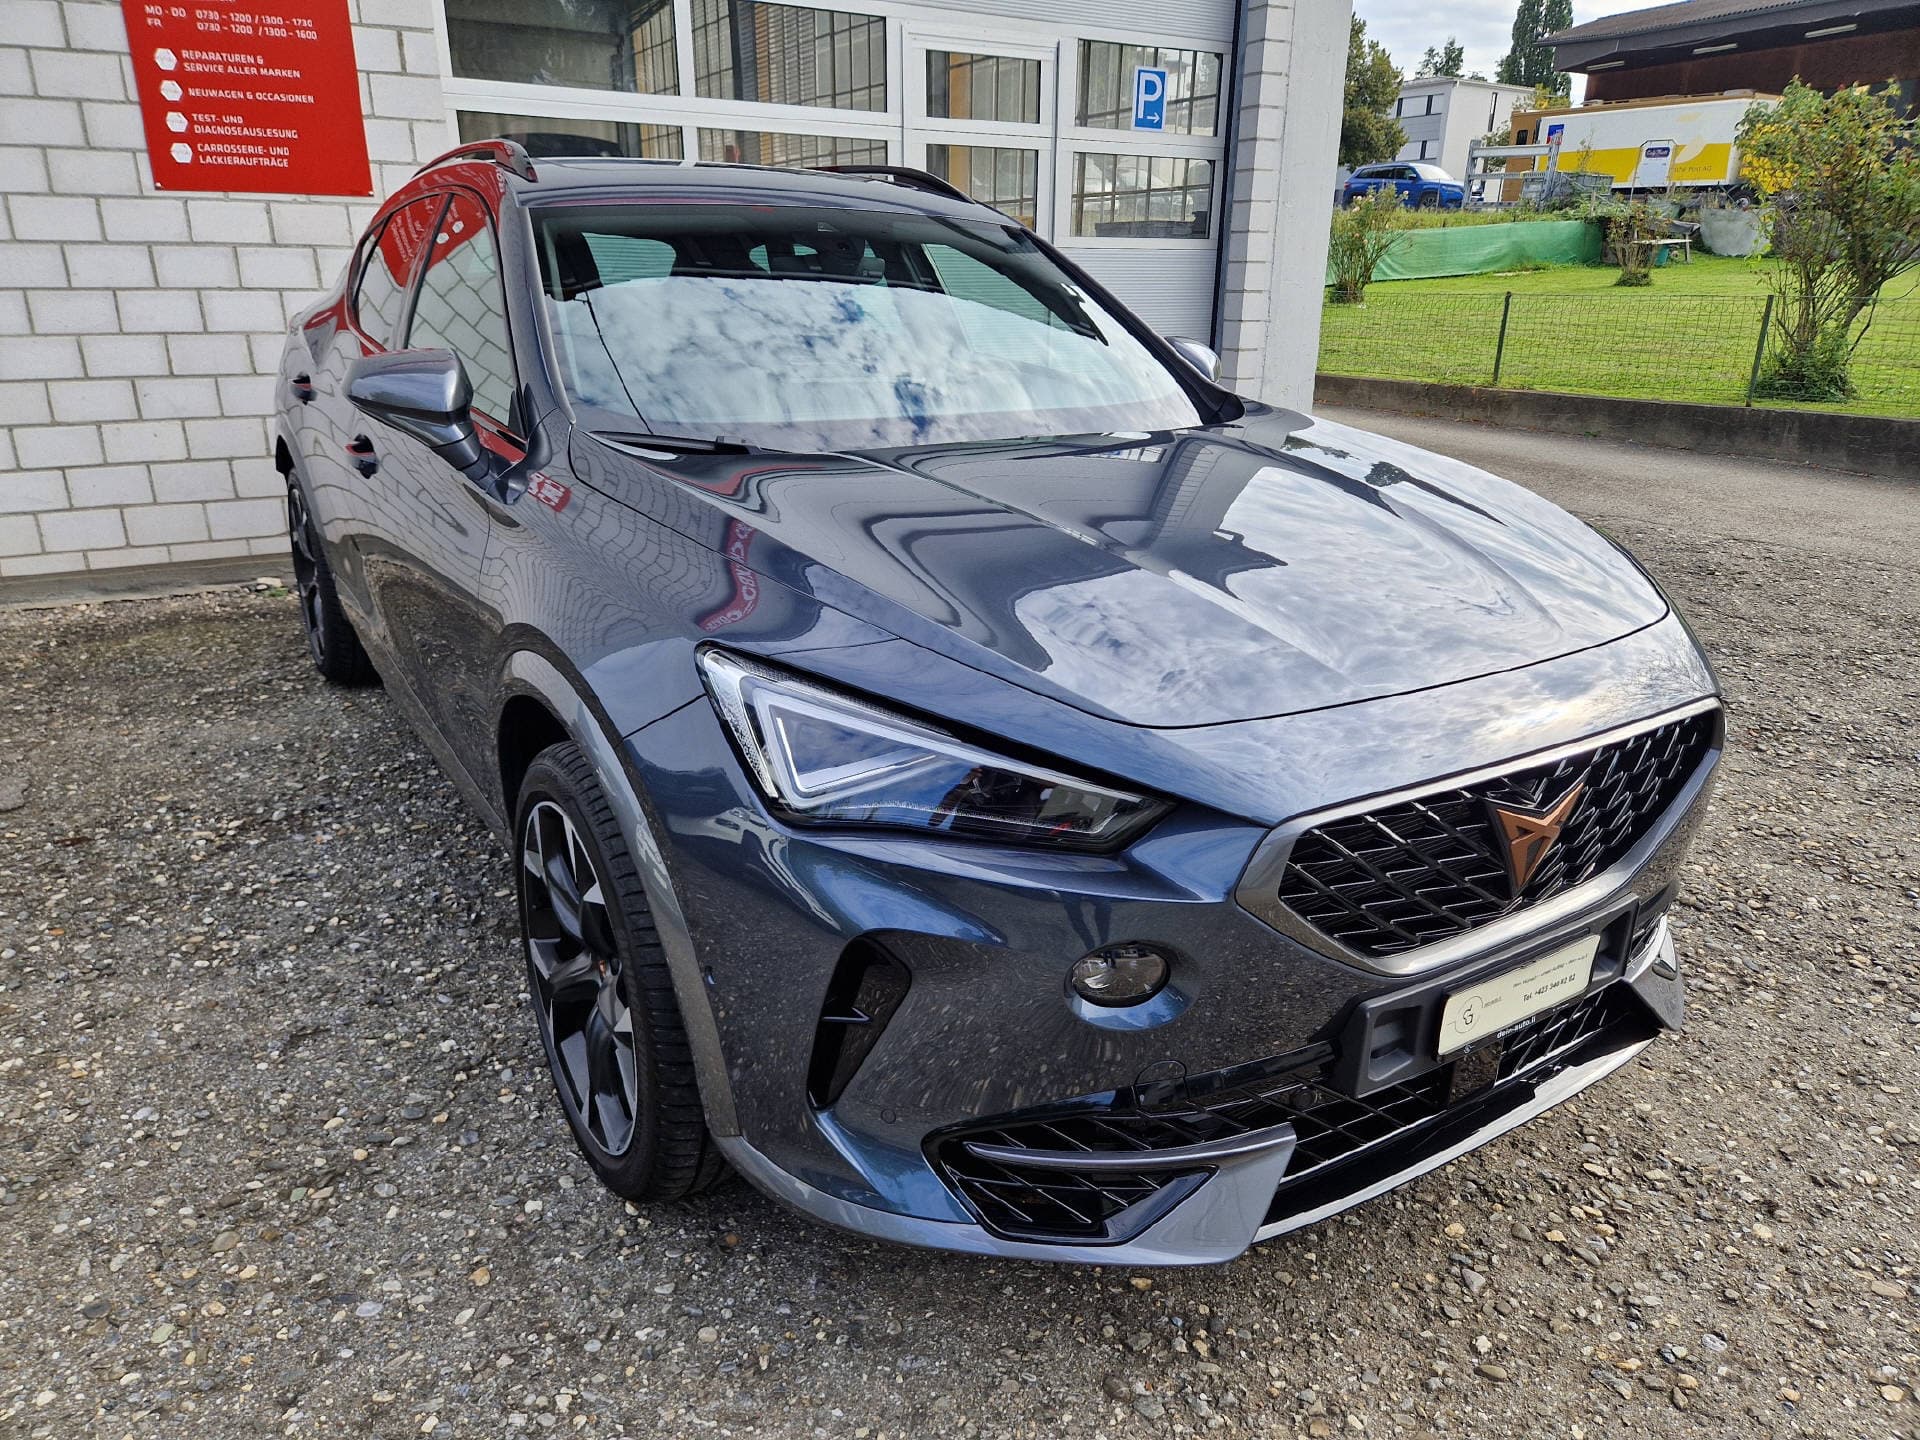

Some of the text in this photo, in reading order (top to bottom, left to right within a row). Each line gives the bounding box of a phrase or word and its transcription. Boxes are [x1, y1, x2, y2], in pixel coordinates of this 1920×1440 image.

[145, 5, 163, 16] MO
[171, 7, 186, 18] DO
[195, 9, 220, 20] 0730
[230, 12, 251, 24] 1200
[261, 15, 283, 25] 1300
[292, 18, 313, 28] 1730
[147, 18, 162, 28] FR
[197, 22, 220, 32] 0730
[230, 24, 253, 35] 1200
[296, 29, 317, 40] 1600
[181, 50, 264, 65] REPARATUREN &
[183, 62, 301, 79] SERVICE ALLER MARKEN
[188, 87, 315, 104] NEUWAGEN & OCCASIONEN
[1137, 72, 1163, 119] P
[192, 113, 244, 124] TEST- UND
[194, 124, 298, 139] DIAGNOSEAUSLESUNG
[197, 143, 290, 156] CARROSSERIE- UND
[199, 155, 289, 168] LACKIERAUFTRÄGE
[1497, 1016, 1536, 1039] dein-auto.li
